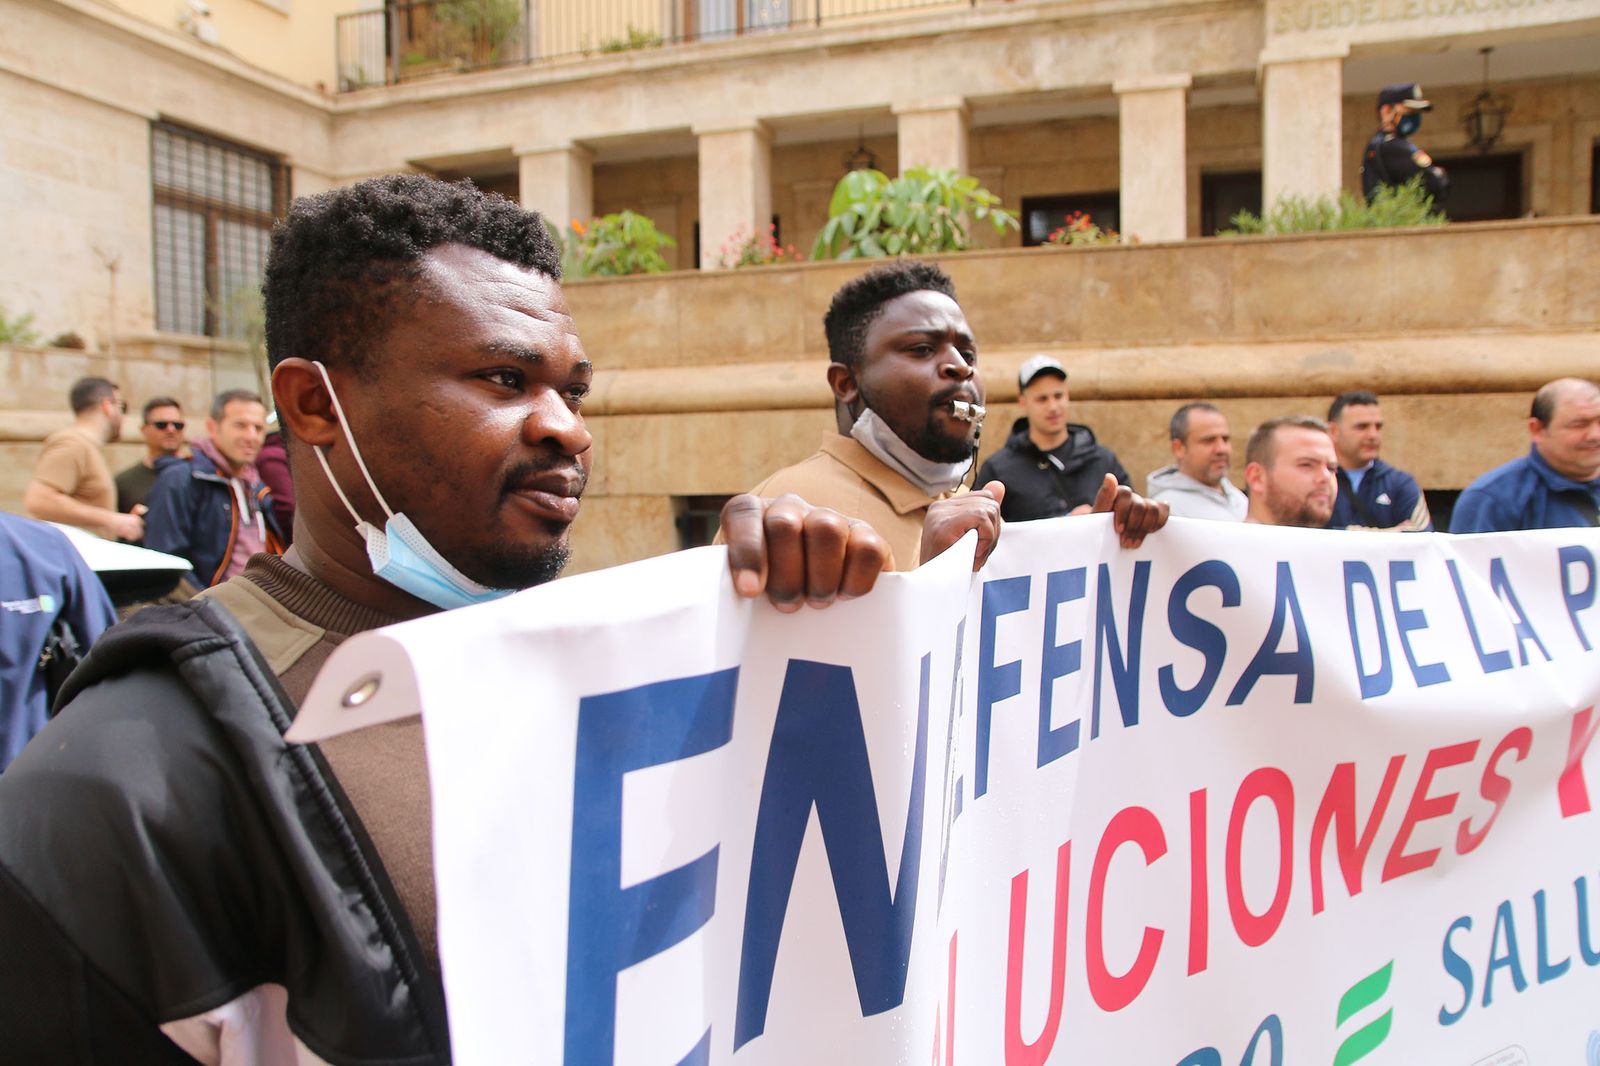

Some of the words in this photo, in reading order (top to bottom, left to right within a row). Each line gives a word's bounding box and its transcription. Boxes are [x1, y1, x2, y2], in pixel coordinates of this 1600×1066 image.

[1274, 0, 1555, 34] SUBDELEGAC
[563, 651, 931, 1066] EN
[951, 558, 1315, 822] FENSA
[1342, 559, 1451, 700] DE
[1447, 556, 1553, 674] LA
[1557, 545, 1597, 652] P
[932, 726, 1533, 1066] UCIONES
